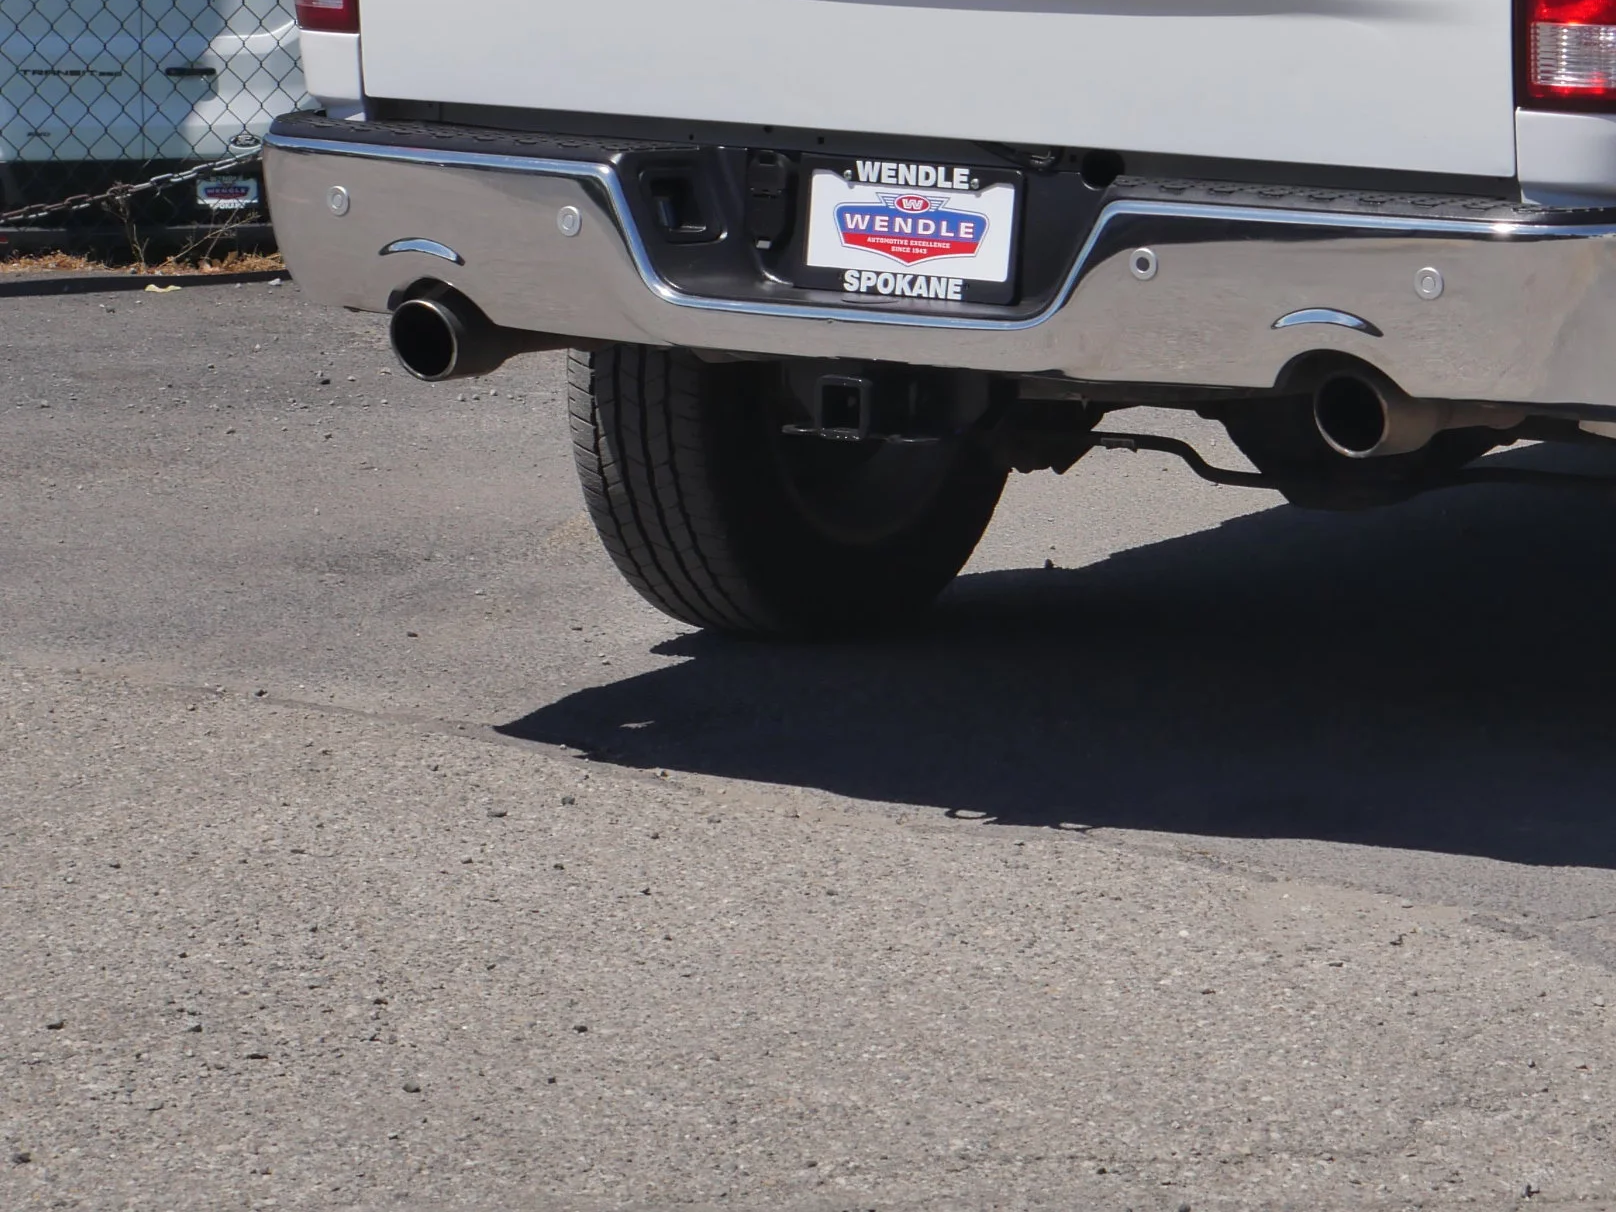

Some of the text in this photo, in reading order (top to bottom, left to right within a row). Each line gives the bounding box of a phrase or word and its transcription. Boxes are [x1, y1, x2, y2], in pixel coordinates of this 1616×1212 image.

[856, 160, 970, 189] WENDLE
[901, 198, 924, 211] W
[844, 213, 974, 238] WENDLE
[867, 236, 950, 250] AUTOMOTIVE EXCELLENCE
[891, 245, 928, 255] SINCE 1943
[843, 269, 963, 301] SPOKANE
